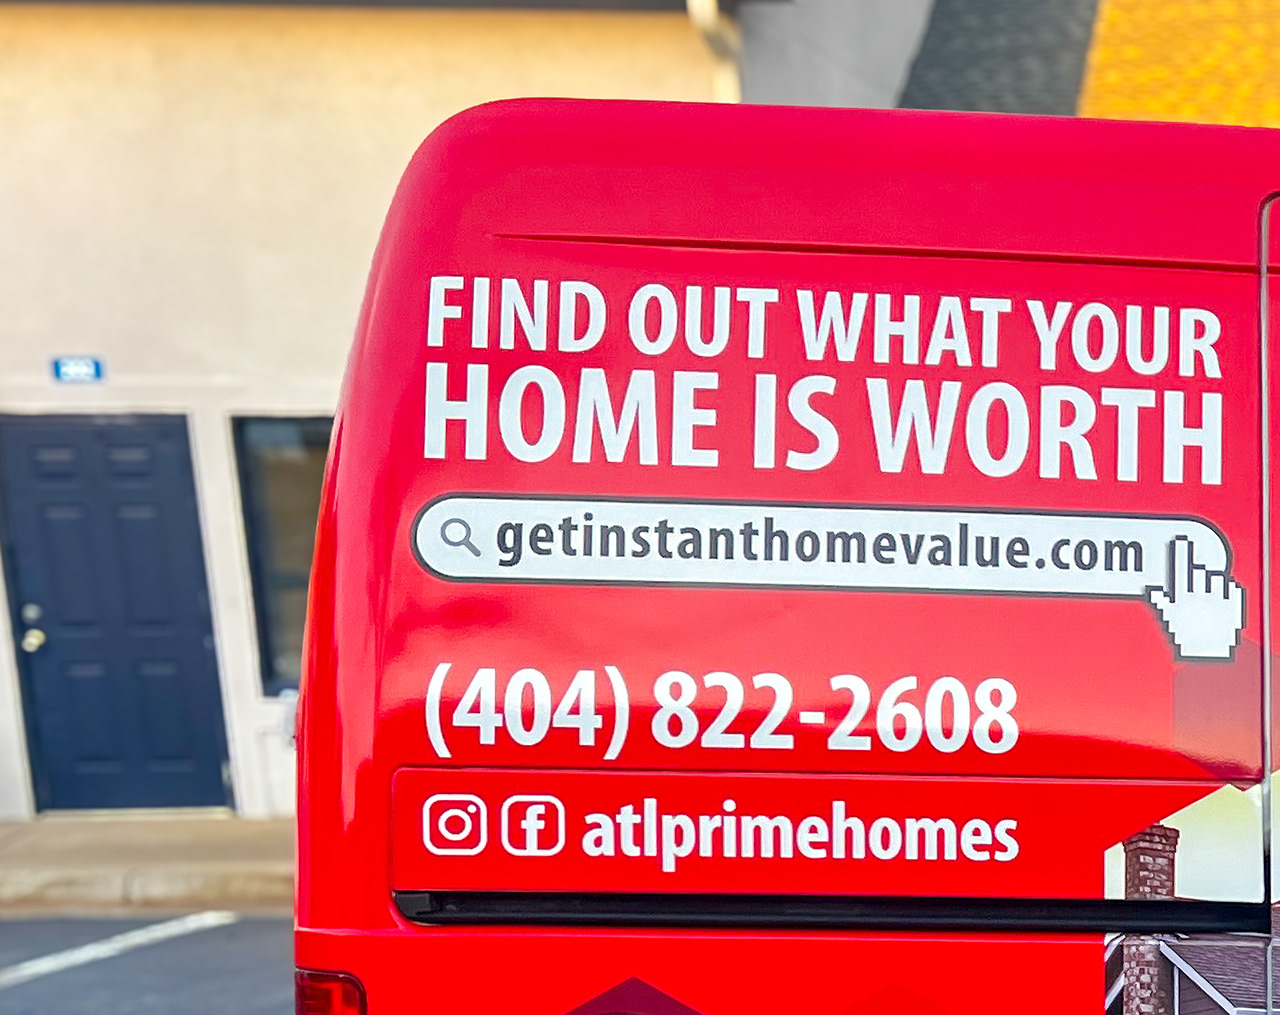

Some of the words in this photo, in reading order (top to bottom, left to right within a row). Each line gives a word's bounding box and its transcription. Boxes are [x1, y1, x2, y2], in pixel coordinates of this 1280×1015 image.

[428, 276, 606, 352] FIND
[629, 284, 778, 358] OUT
[795, 290, 1012, 367] WHAT
[1026, 300, 1222, 378] YOUR
[424, 362, 718, 467] HOME
[754, 374, 839, 470] IS
[866, 378, 1222, 486] WORTH
[497, 513, 1144, 572] getinstanthomevalue.com
[426, 663, 629, 759] (404)
[652, 671, 1018, 753] 822-2608
[583, 798, 1018, 872] atlprimehomes
